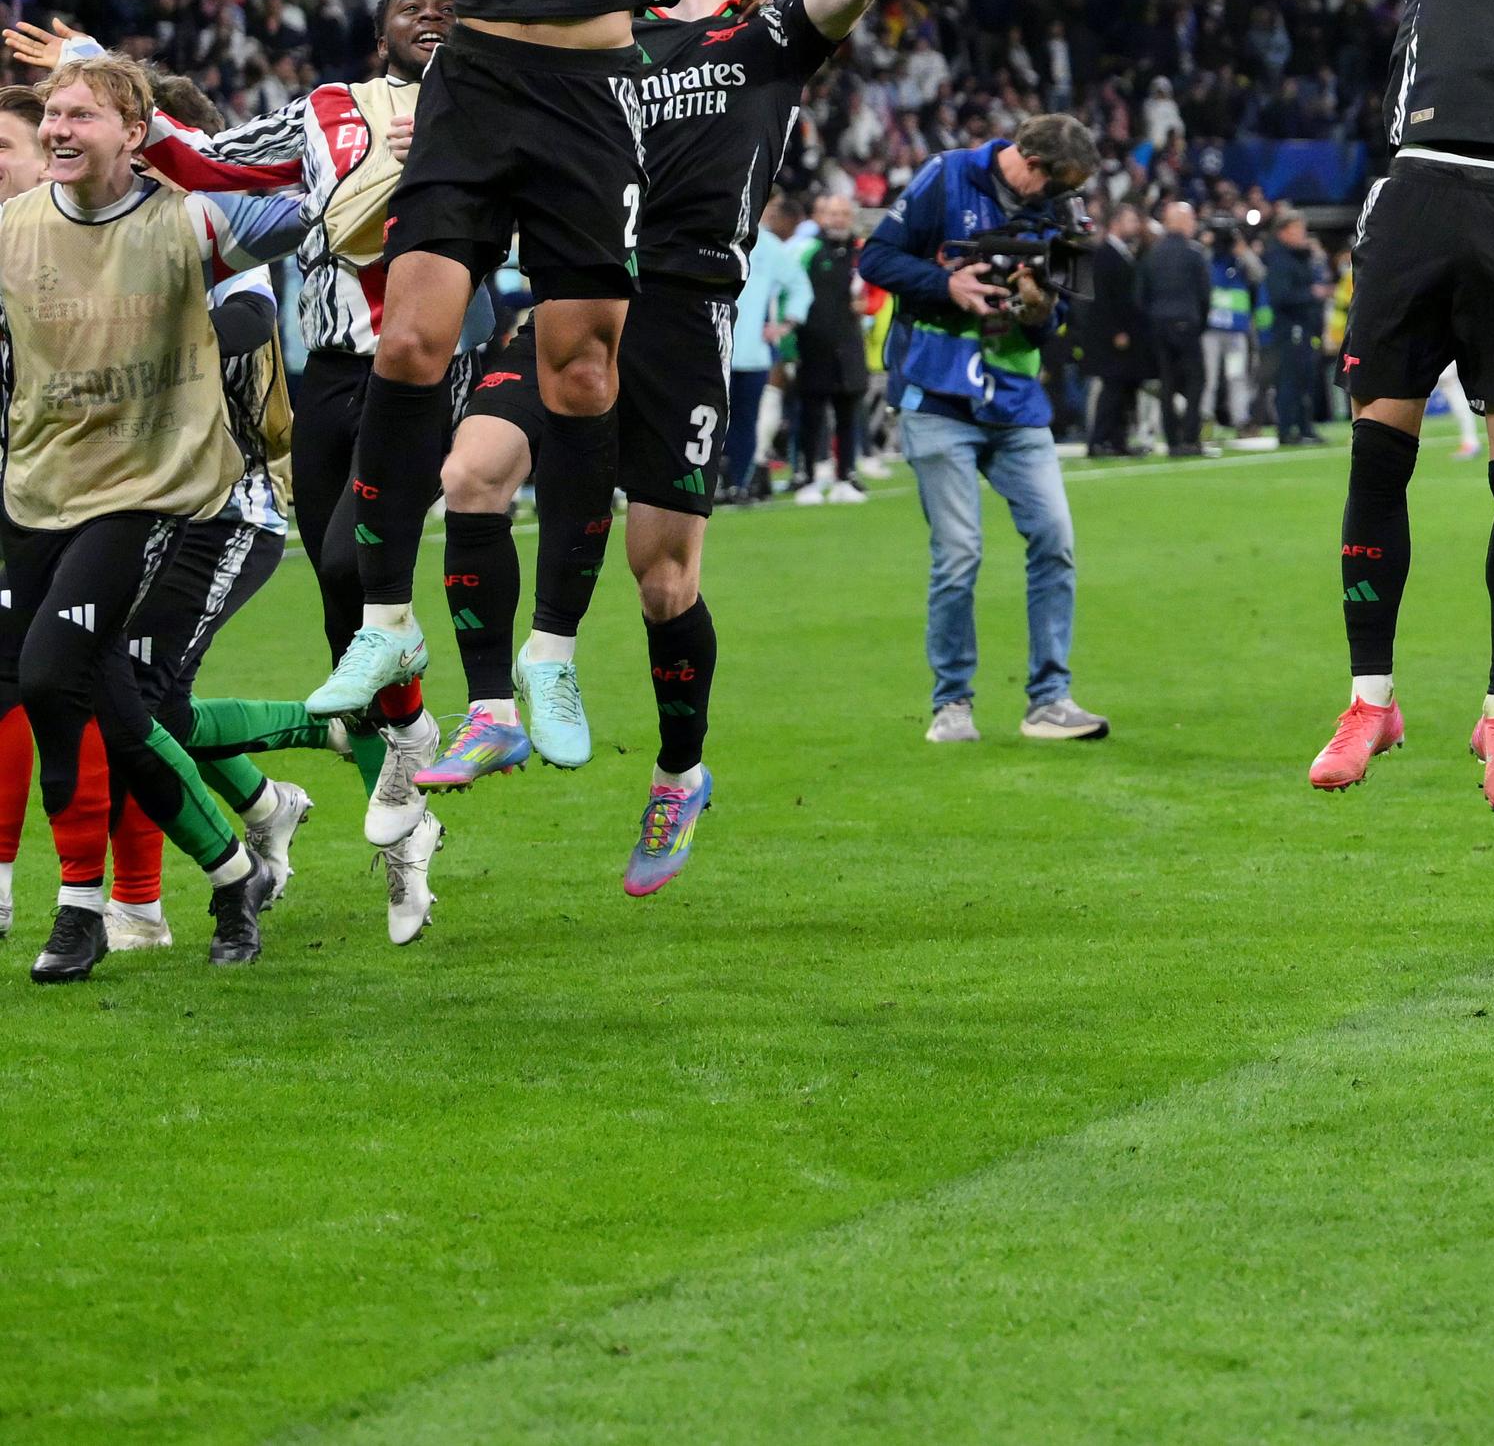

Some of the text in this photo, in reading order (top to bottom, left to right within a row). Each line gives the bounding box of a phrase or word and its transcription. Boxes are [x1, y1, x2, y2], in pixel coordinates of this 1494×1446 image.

[663, 90, 728, 122] BETTER
[622, 183, 641, 249] 2
[684, 403, 719, 467] 3
[1342, 543, 1385, 561] AFC
